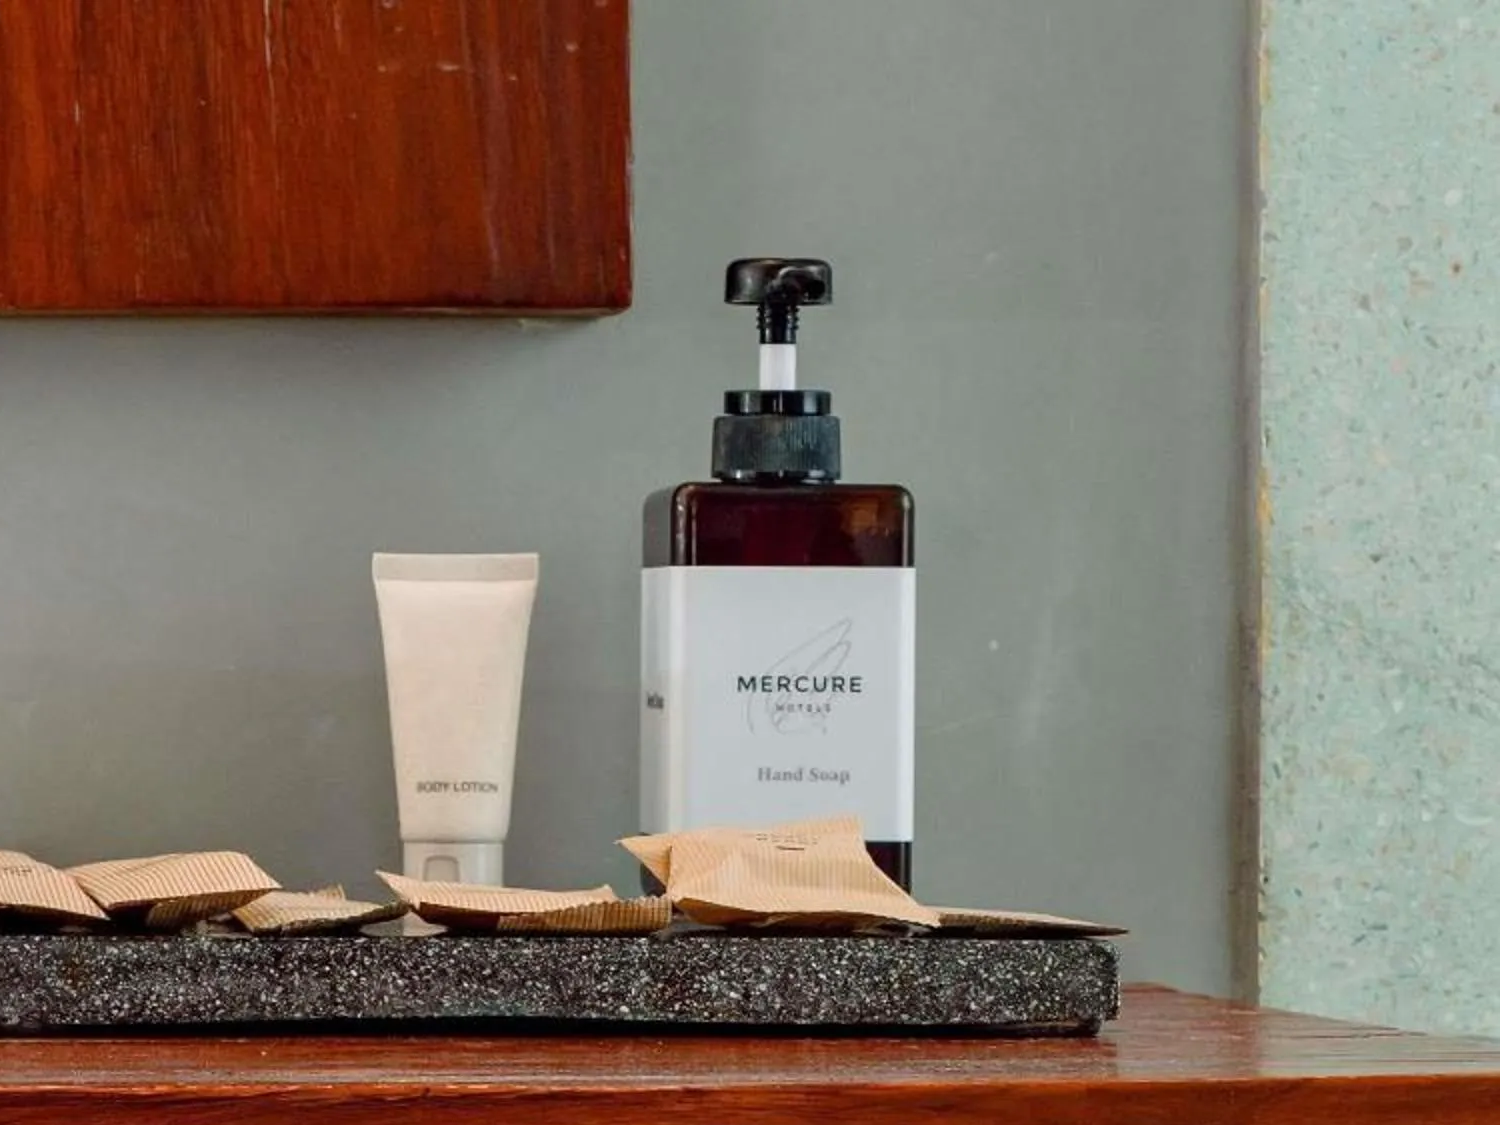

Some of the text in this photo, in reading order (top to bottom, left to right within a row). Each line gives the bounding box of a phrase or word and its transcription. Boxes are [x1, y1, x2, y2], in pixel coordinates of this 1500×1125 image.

[737, 675, 863, 693] MERCURE
[757, 767, 851, 785] Hand Soap
[453, 781, 498, 793] LOTION
